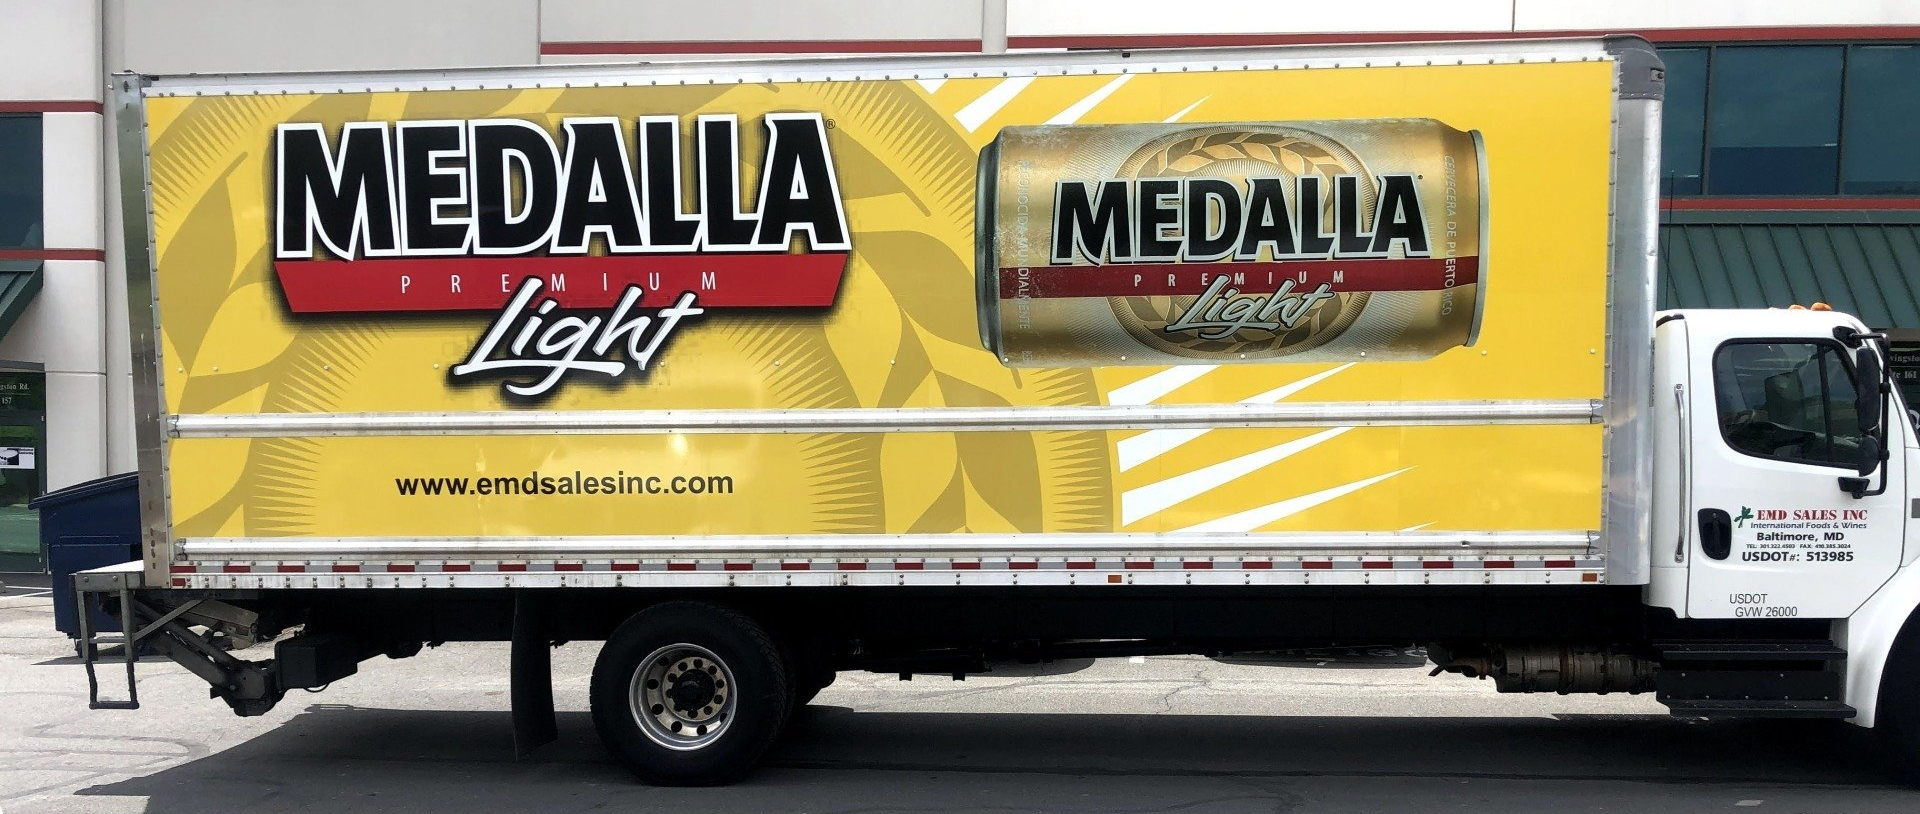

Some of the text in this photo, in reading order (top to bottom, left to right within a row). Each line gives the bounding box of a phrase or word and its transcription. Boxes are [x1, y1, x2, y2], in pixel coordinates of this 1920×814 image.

[277, 112, 852, 261] MEDALLA
[1051, 175, 1431, 265] MEDALLA
[1441, 155, 1457, 316] CERVECERA DE PUERTO RICO
[400, 271, 717, 294] PREMIUM
[1134, 270, 1344, 287] PREMIUM
[1164, 274, 1335, 340] Light
[453, 278, 704, 396] Light
[395, 471, 734, 495] www.emdsalesinc.com
[1757, 510, 1868, 520] EMD SALES INC
[1756, 532, 1845, 542] Baltimore, MD
[1741, 551, 1854, 562] USDOT#: 513985
[1729, 593, 1768, 604] USDOT
[1735, 606, 1798, 617] GVW 26000
